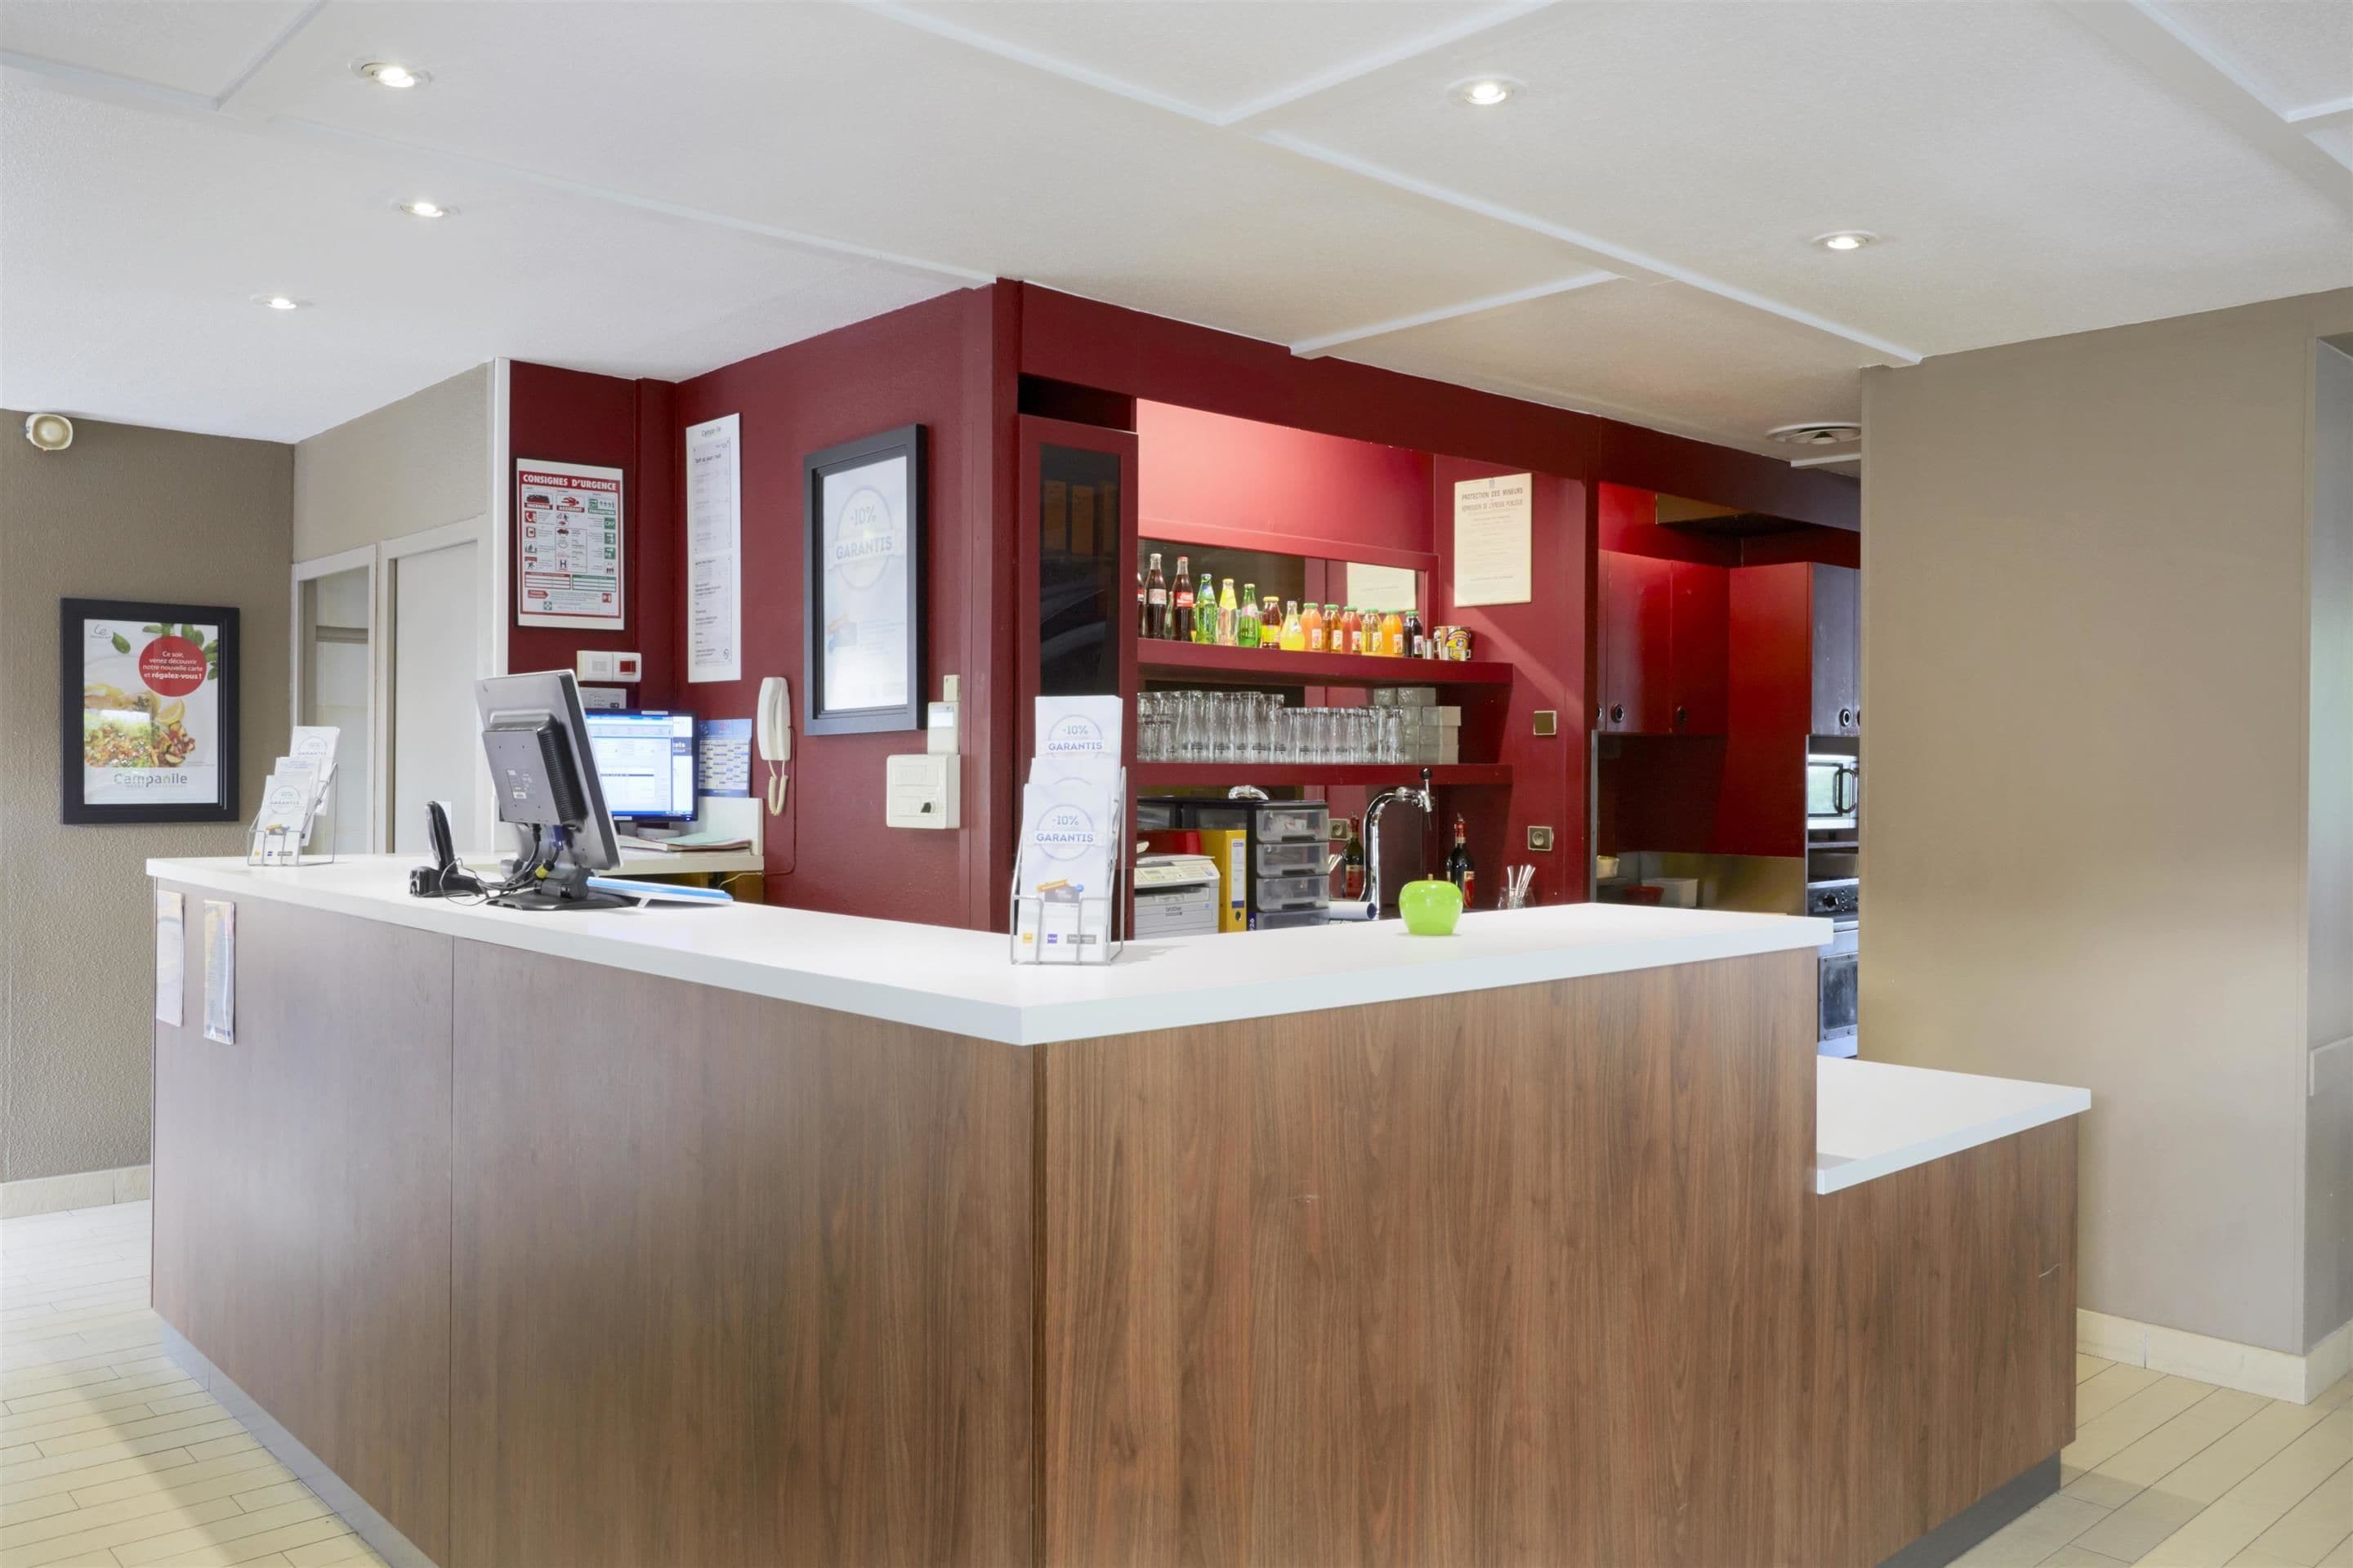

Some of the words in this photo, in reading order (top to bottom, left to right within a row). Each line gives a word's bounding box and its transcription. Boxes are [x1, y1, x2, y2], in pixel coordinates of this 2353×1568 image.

[523, 474, 568, 486] CONSIGNES
[572, 480, 617, 490] D'URGENCE
[1462, 492, 1489, 501] PROTECTION
[1491, 489, 1500, 498] DES
[1503, 487, 1523, 495] MINEURS
[851, 504, 877, 524] -10%
[837, 536, 892, 560] GARANTIS
[152, 672, 198, 680] régalez-vous
[1063, 725, 1088, 735] -10%
[1048, 741, 1103, 751] GARANTIS
[114, 773, 188, 788] Campanile
[1052, 815, 1079, 825] -10%
[1037, 833, 1094, 842] GARANTIS
